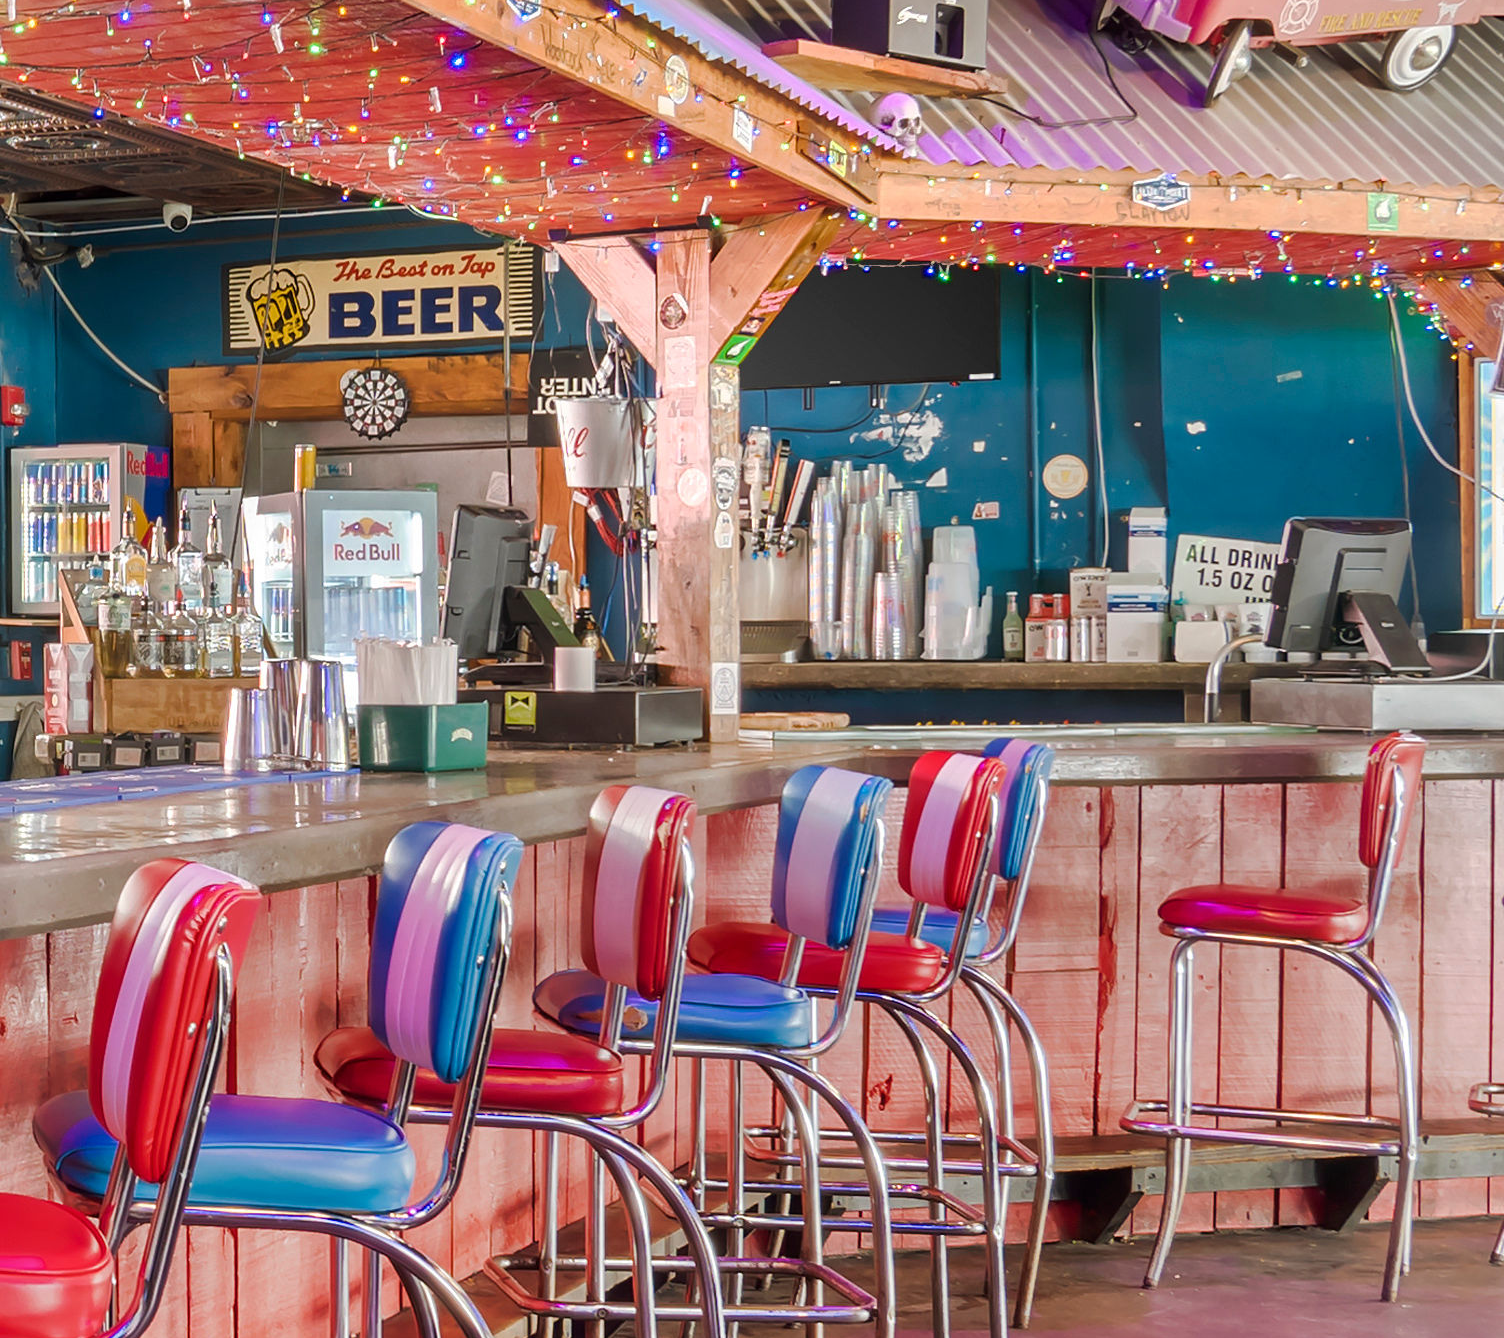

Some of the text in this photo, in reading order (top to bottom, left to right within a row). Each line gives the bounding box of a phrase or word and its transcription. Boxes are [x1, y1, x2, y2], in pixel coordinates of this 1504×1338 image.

[333, 253, 496, 282] The Best on Tap
[328, 285, 505, 338] BEER
[127, 449, 146, 476] Red
[333, 543, 401, 562] Red Bull
[1186, 544, 1219, 564] ALL
[1197, 568, 1254, 591] 1.5 OZ
